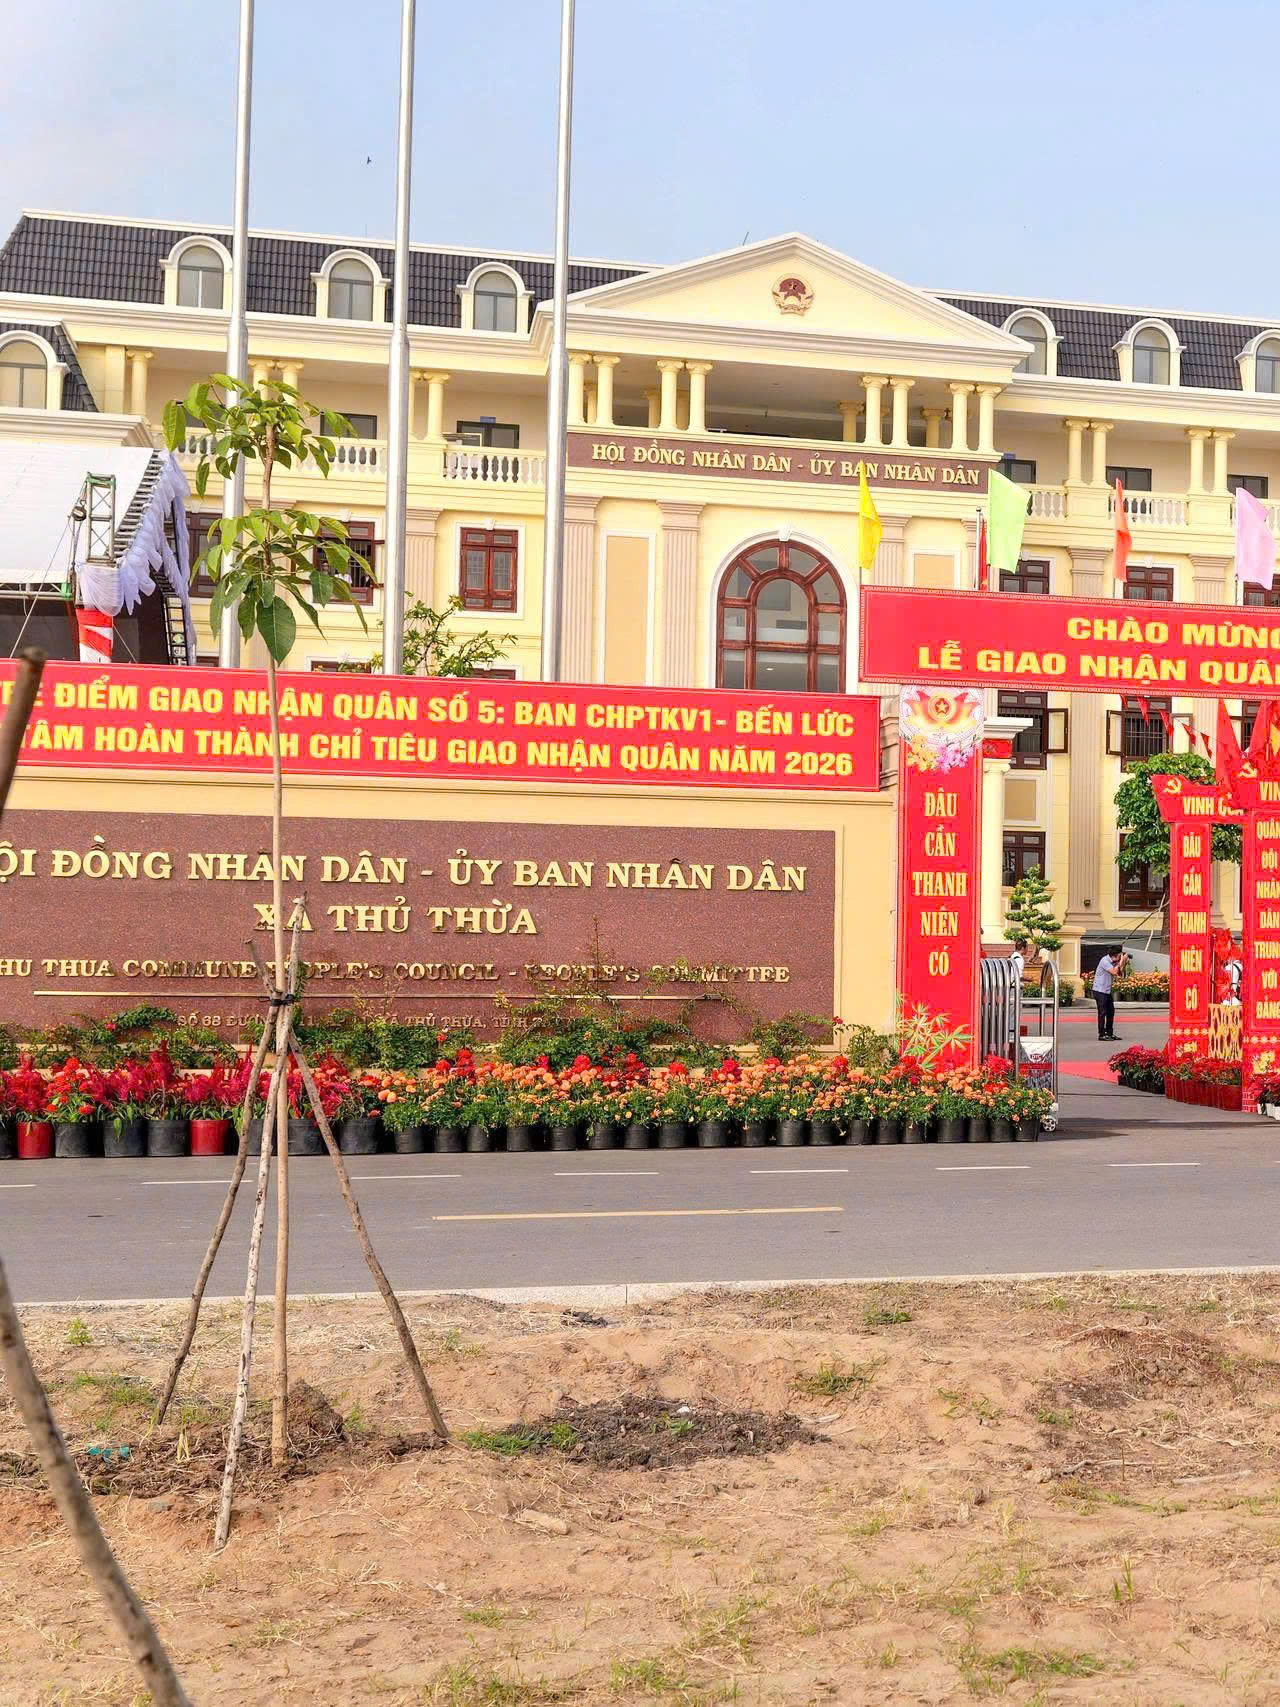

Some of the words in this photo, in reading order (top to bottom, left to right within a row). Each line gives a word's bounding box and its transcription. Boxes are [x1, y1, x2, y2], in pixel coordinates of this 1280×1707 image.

[591, 441, 626, 465] HỘI
[633, 439, 686, 467] ĐỒNG
[691, 448, 747, 470] NHÂN
[752, 452, 792, 473] DÂN
[810, 452, 836, 476] ỦY
[883, 462, 937, 482] NHÂN
[942, 464, 980, 485] DÂN
[1066, 616, 1169, 645] CHÀO
[918, 640, 963, 671] LỄ
[976, 649, 1067, 675] GIAO
[1079, 654, 1187, 684] NHẬN
[53, 675, 138, 711] ĐIỂM
[148, 687, 224, 714] GIAO
[332, 690, 419, 721] QUÂN
[427, 690, 471, 723] SỐ
[477, 699, 506, 725] 5:
[514, 702, 577, 727] BAN
[735, 704, 794, 735] BẾN
[800, 708, 855, 738] LỨC
[20, 719, 84, 751] ÂM
[94, 722, 184, 754] HOÀN
[194, 726, 299, 757] THÀNH
[309, 728, 363, 760] CHỈ
[370, 732, 438, 762] TIÊU
[447, 739, 518, 765] GIAO
[527, 739, 611, 773] NHẬN
[619, 742, 700, 772] QUÂN
[708, 745, 776, 774] NĂM
[784, 751, 853, 776] 2026
[924, 787, 957, 817] ĐÂU
[1182, 796, 1215, 816] VINH
[924, 824, 956, 857] CẦN
[1183, 831, 1202, 859] ĐÂU
[51, 834, 173, 880] ĐỒNG
[187, 848, 307, 882] NHÂN
[320, 849, 408, 885] DÂN
[420, 869, 434, 877] -
[447, 848, 503, 886] ỦY
[512, 859, 595, 888] BAN
[605, 857, 715, 890] NHÂN
[726, 858, 808, 892] DÂN
[911, 871, 968, 897] THANH
[327, 895, 412, 933] THỦ
[425, 898, 538, 935] THỪA
[920, 905, 959, 937] NIÊN
[1177, 911, 1207, 934] THANH
[1259, 907, 1280, 929] DÂN
[41, 959, 116, 978] THUA
[122, 959, 258, 979] COMMUNE
[391, 962, 501, 982] COUNCIL
[928, 945, 951, 977] CÓ
[1180, 944, 1203, 973] NIÊN
[1184, 983, 1199, 1012] CÓ
